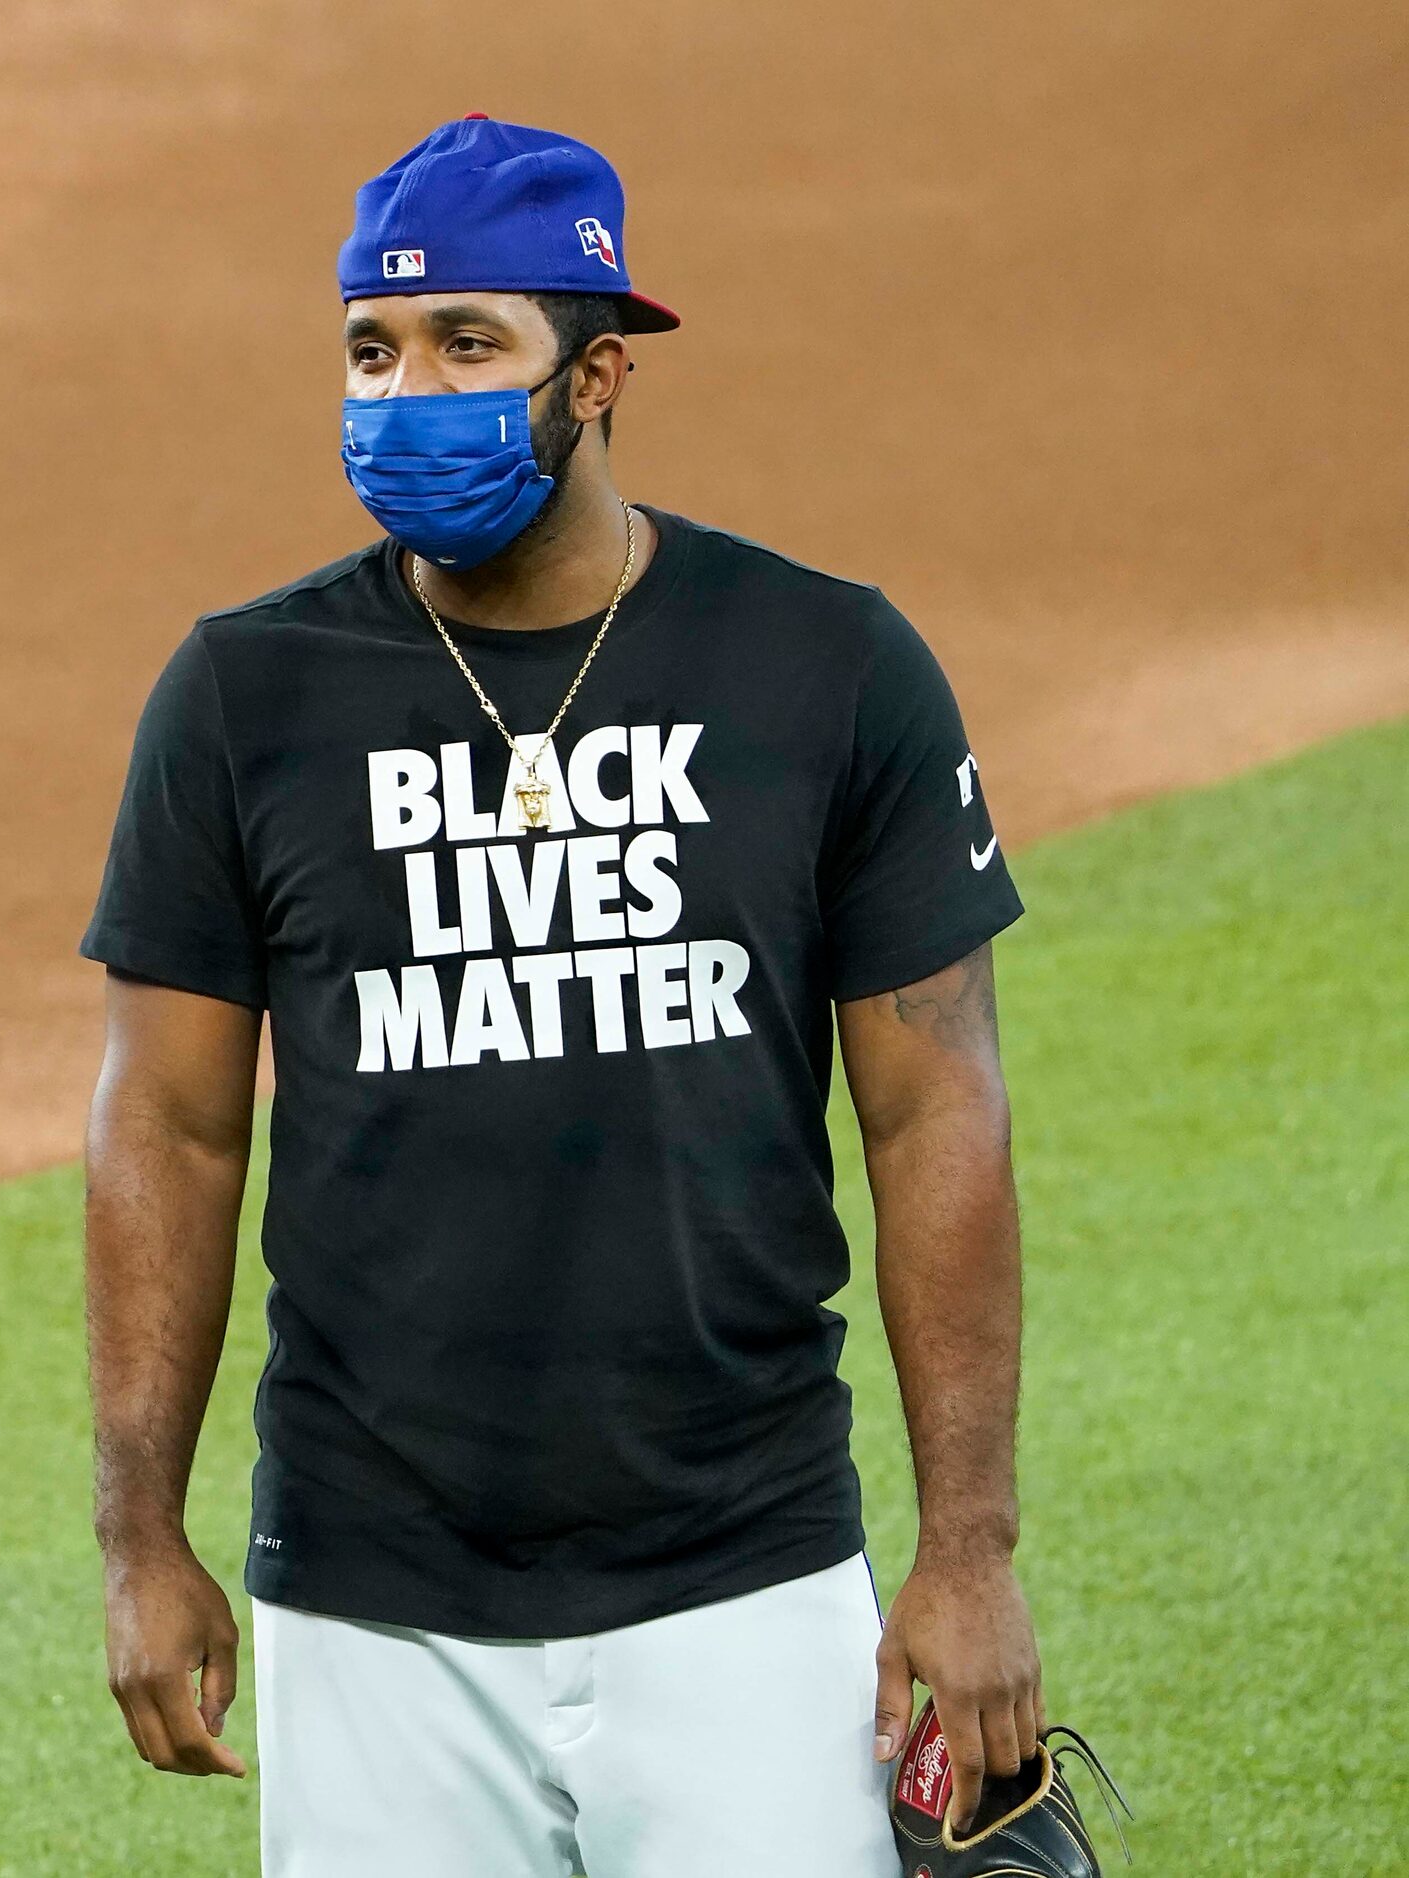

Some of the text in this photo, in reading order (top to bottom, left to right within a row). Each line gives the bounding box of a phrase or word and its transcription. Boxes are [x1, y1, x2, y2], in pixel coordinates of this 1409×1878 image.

[497, 414, 507, 442] 1
[368, 724, 711, 850] BLACK
[404, 830, 683, 957] LIVES
[354, 939, 752, 1072] MATTER
